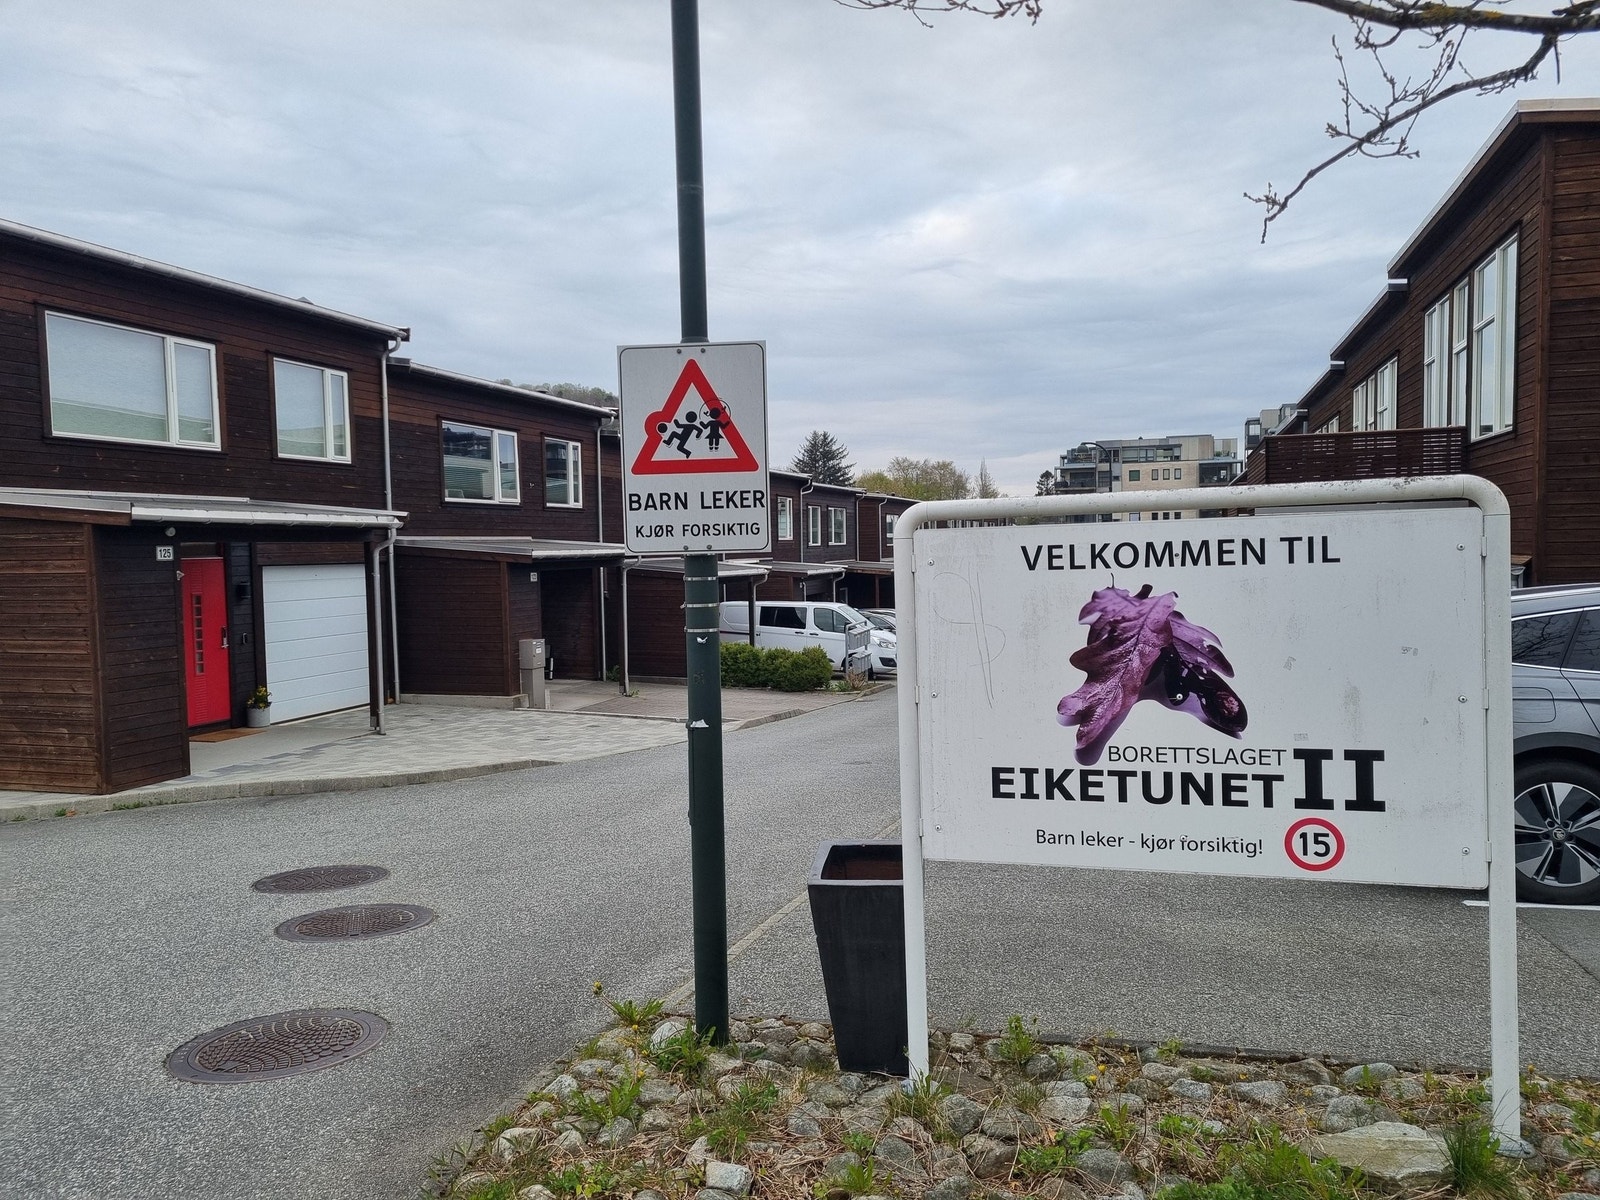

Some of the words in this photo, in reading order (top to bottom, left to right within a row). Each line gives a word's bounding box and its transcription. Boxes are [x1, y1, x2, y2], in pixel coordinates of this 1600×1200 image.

[628, 491, 688, 511] BARN
[700, 489, 766, 509] LEKER
[635, 524, 674, 538] KJØR
[682, 522, 761, 537] FORSIKTIG
[158, 548, 172, 558] 125
[1020, 537, 1266, 571] VELKOMMEN
[1279, 535, 1341, 564] TIL
[1107, 745, 1287, 766] BORETTSLAGET
[991, 766, 1285, 809] EIKETUNET
[1292, 748, 1386, 812] II
[1036, 829, 1075, 846] Barn
[1081, 830, 1124, 848] leker
[1140, 833, 1175, 853] kjør
[1180, 834, 1264, 858] forsiktig!
[1299, 832, 1331, 858] 15
